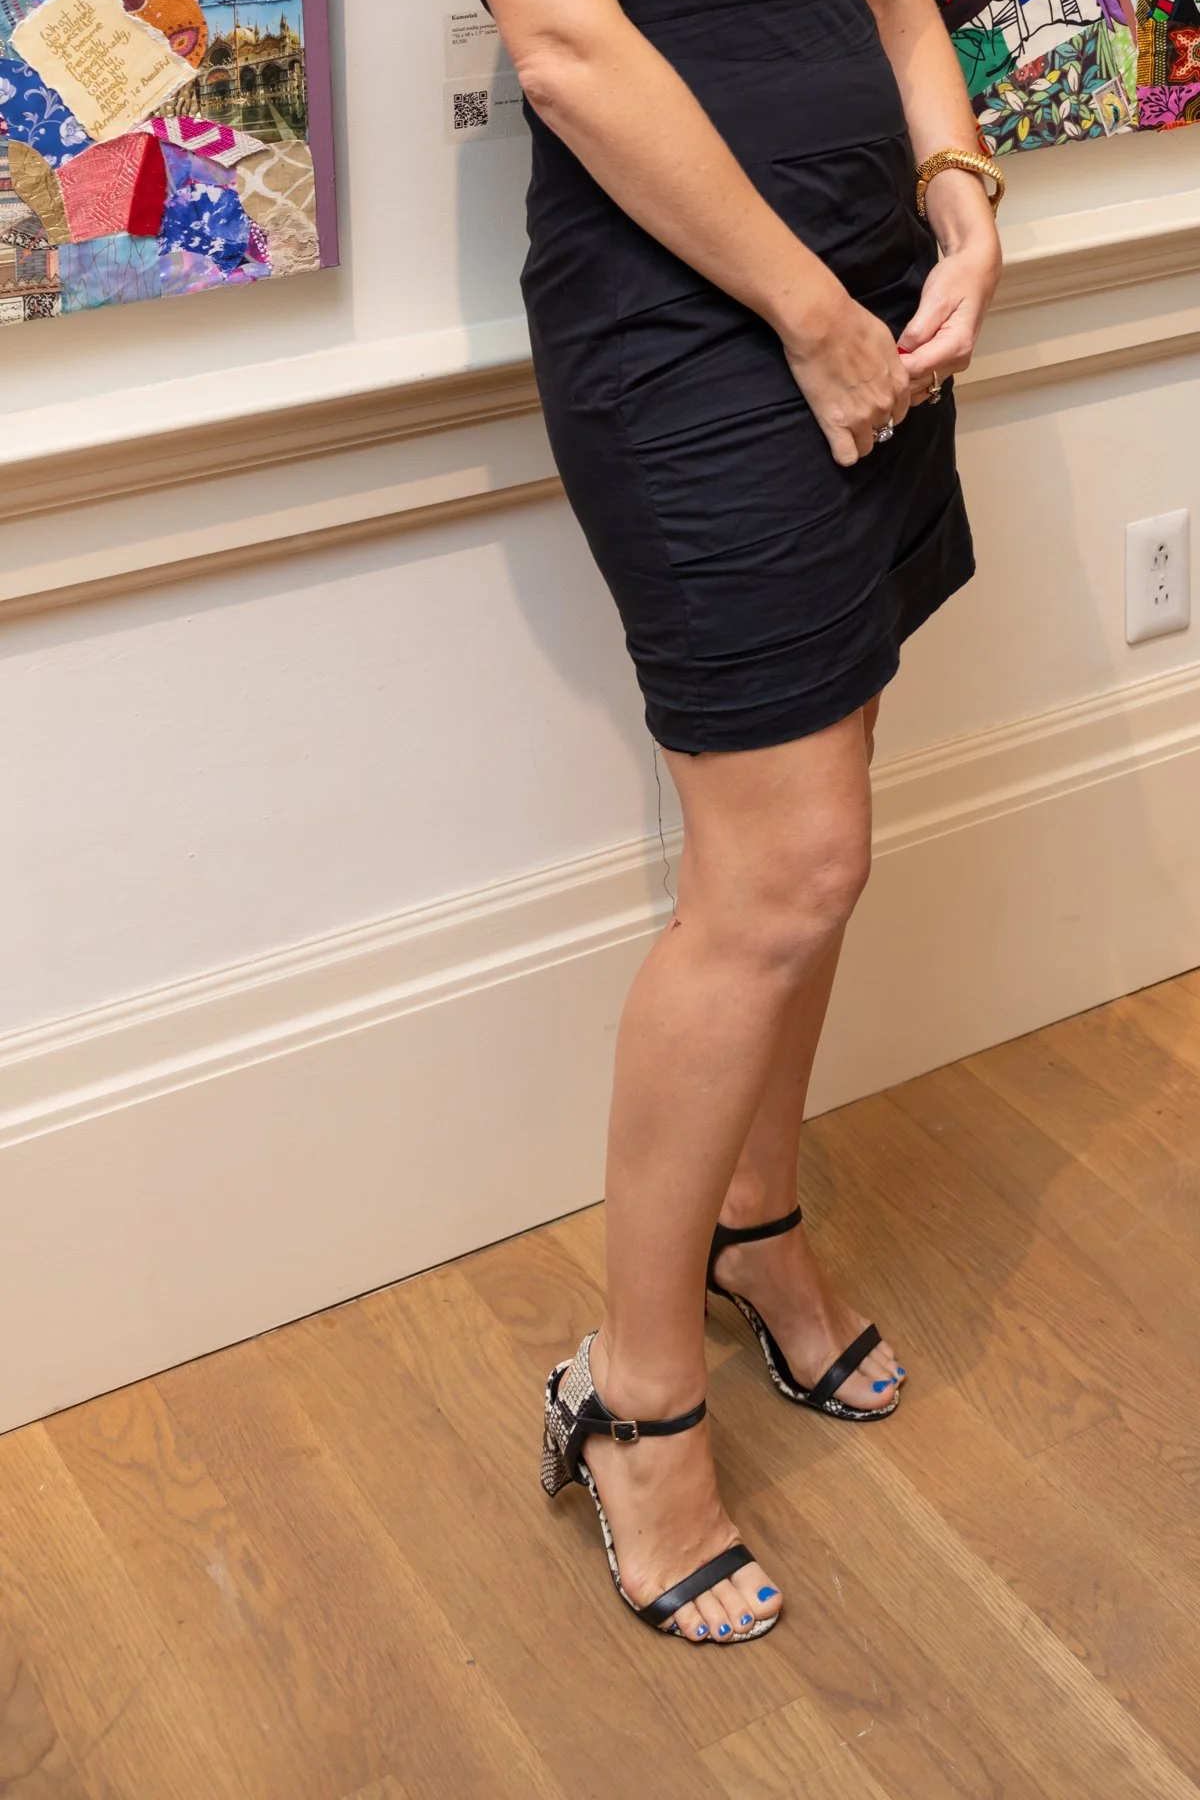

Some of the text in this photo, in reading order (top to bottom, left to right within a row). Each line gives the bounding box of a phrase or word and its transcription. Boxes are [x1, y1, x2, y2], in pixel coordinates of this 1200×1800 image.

[40, 10, 71, 41] What
[62, 3, 97, 34] allowed
[70, 22, 104, 52] become
[130, 86, 142, 98] is
